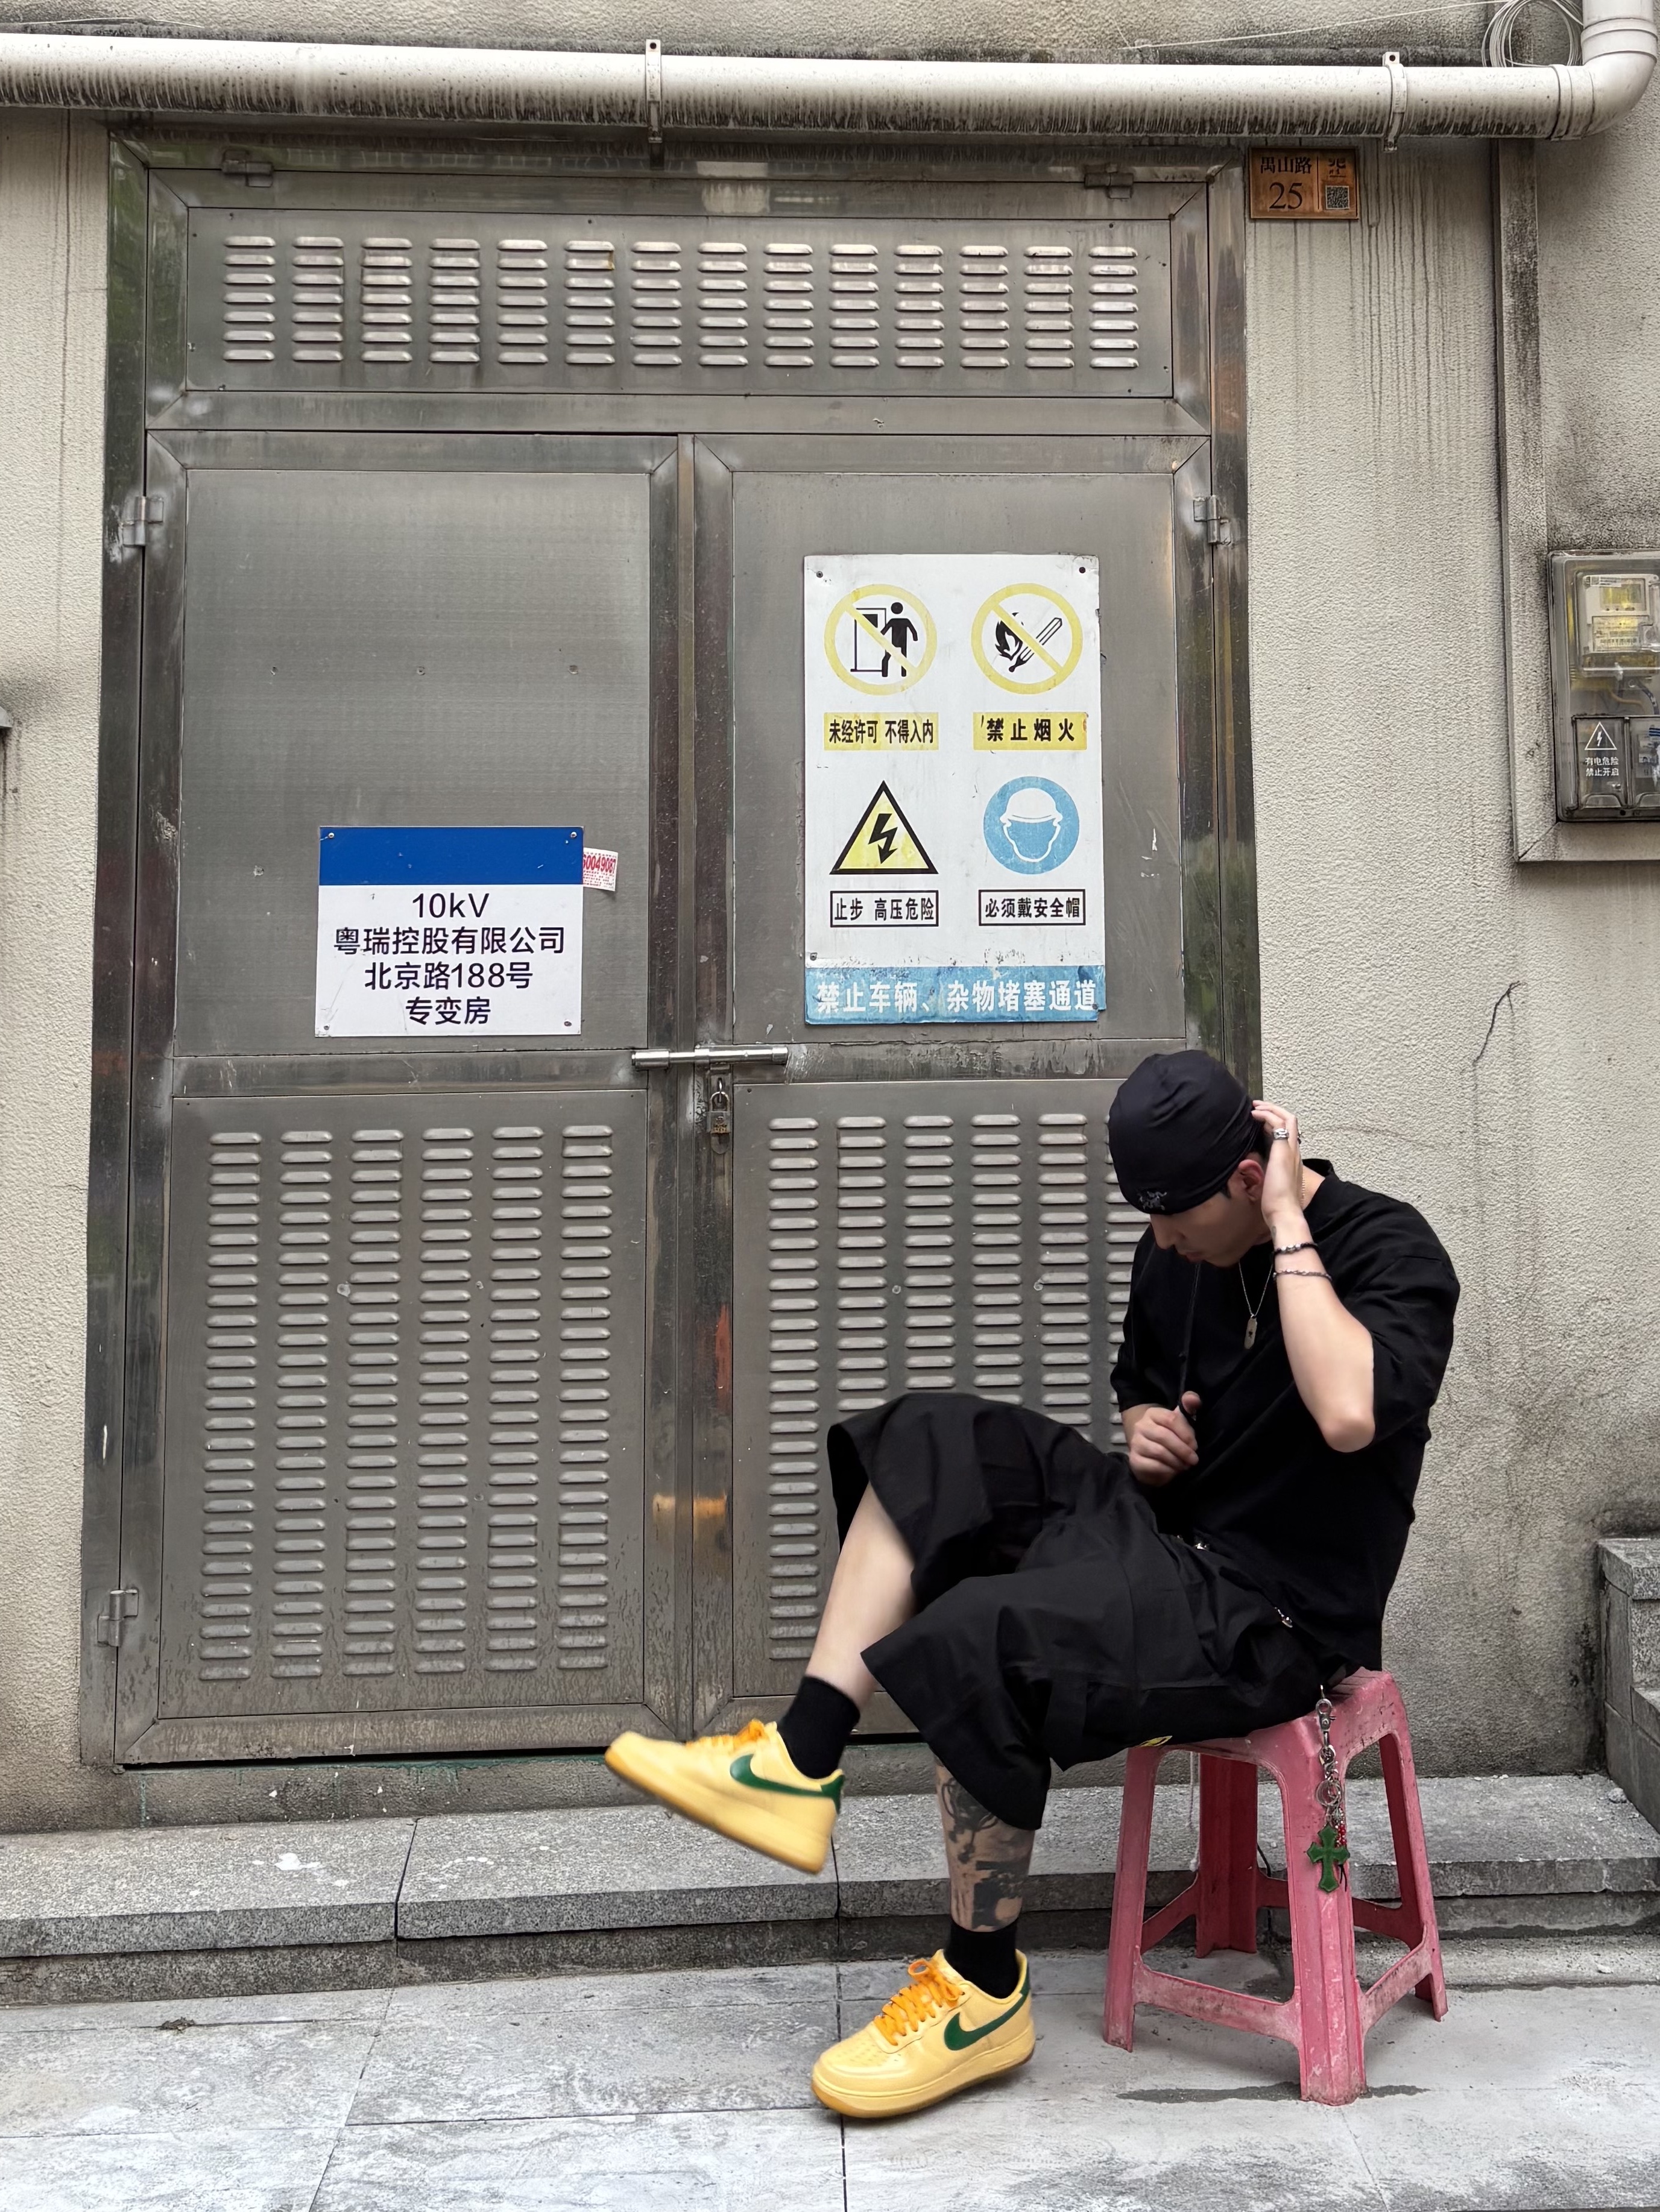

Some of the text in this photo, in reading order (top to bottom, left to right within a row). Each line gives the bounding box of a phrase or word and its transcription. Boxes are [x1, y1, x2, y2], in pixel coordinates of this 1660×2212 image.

[1260, 156, 1312, 173] 禺山路
[1269, 182, 1302, 210] 25
[828, 719, 934, 744] 未经许可 不得入内
[985, 717, 1075, 742] 禁止烟火
[1585, 757, 1619, 766] 有电危险
[1585, 767, 1620, 777] 禁止开启
[412, 893, 490, 918] 10kV
[833, 897, 935, 921] 止步 高压危险
[984, 897, 1081, 919] 必须戴安全帽
[333, 927, 565, 956] 粤瑞控股有限公司
[364, 962, 534, 991] 北京路188号
[405, 996, 491, 1026] 专变房
